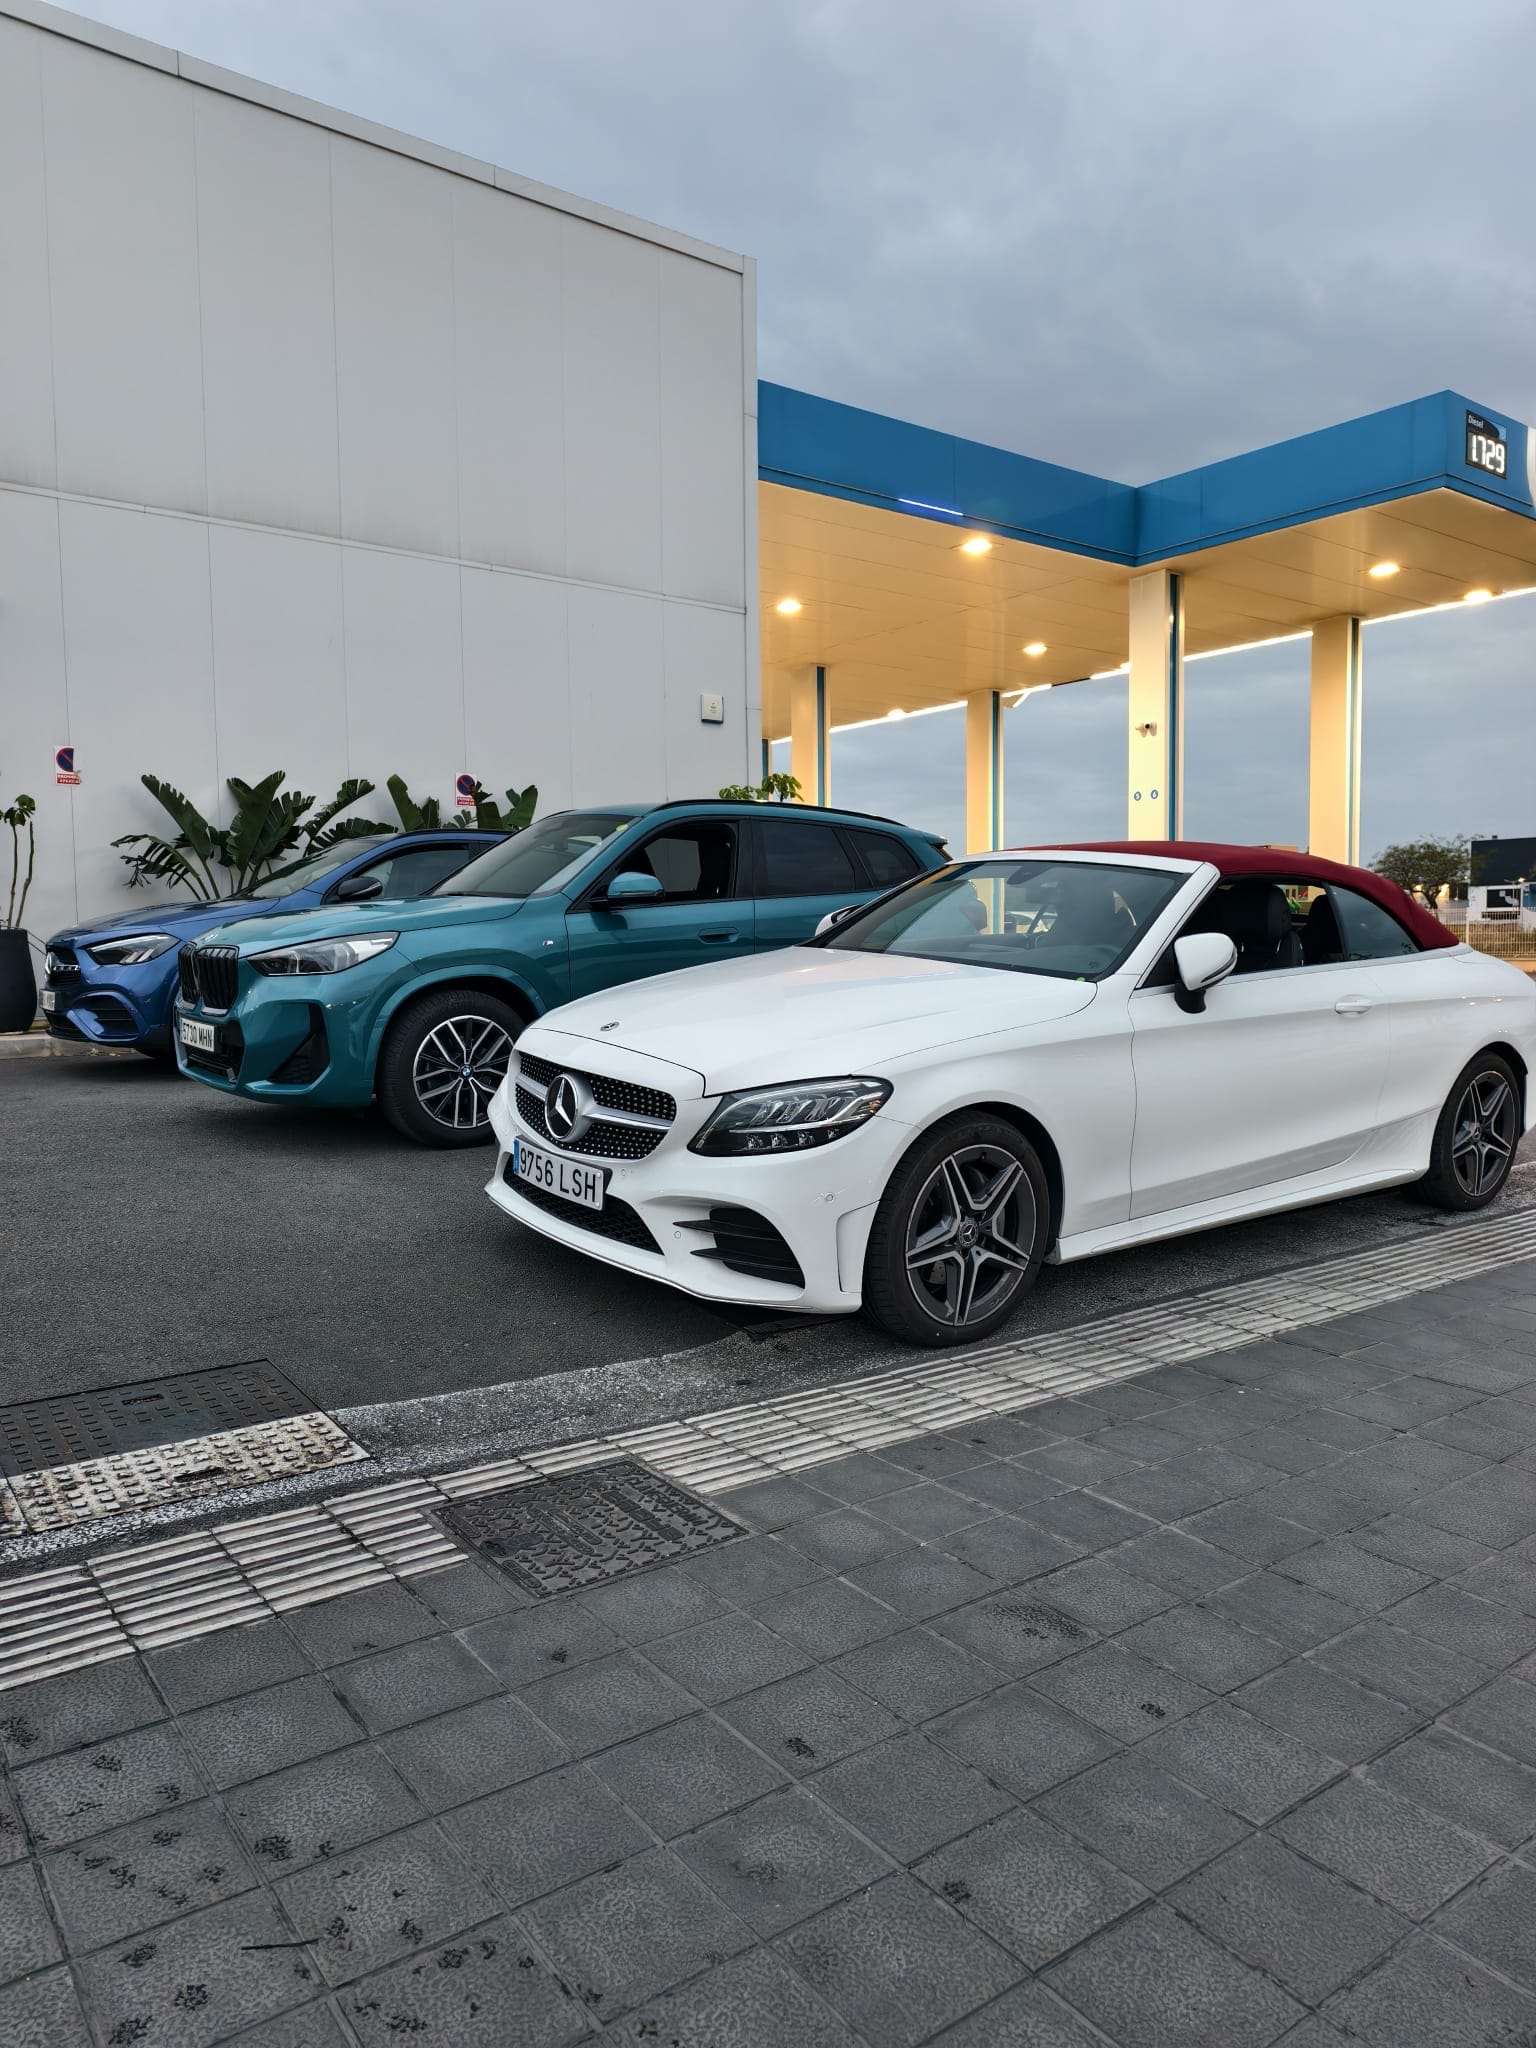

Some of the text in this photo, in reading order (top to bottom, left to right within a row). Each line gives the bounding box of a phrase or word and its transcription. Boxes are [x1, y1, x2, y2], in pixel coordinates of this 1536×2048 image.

[1468, 415, 1483, 428] Diesel
[183, 1022, 212, 1048] 5730 MHN
[520, 1147, 596, 1202] 9756 LSH
